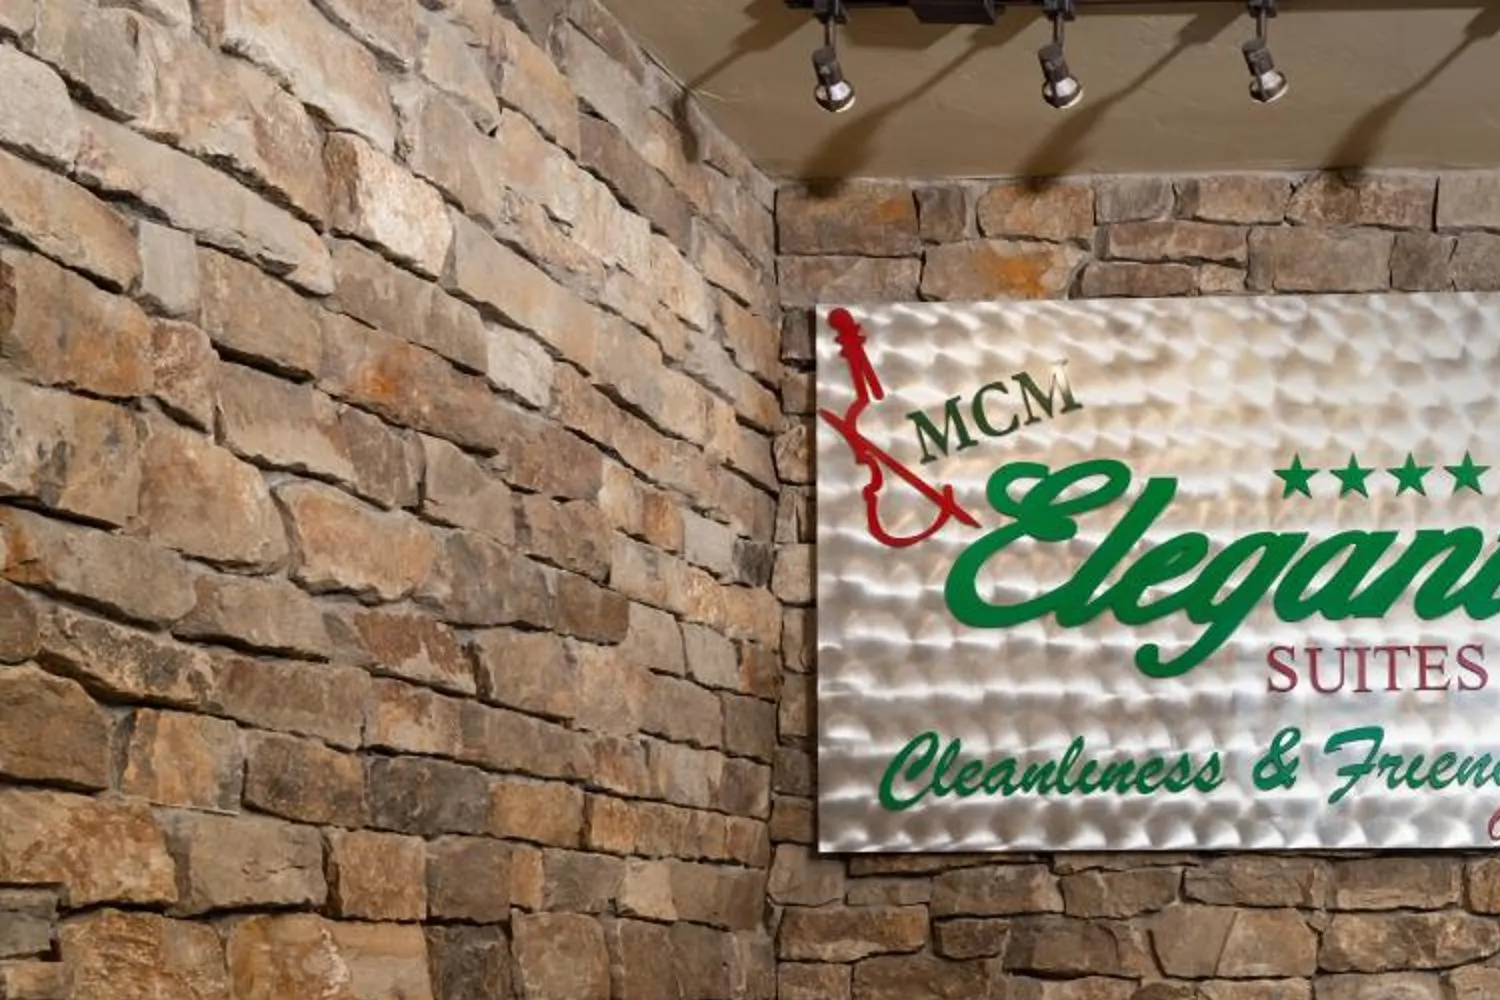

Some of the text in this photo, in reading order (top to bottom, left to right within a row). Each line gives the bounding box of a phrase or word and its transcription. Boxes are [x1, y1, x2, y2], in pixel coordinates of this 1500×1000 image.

[906, 358, 1085, 465] MCM
[1267, 643, 1490, 694] SUITES
[879, 731, 1226, 813] Cleanliness
[1254, 726, 1302, 790] &
